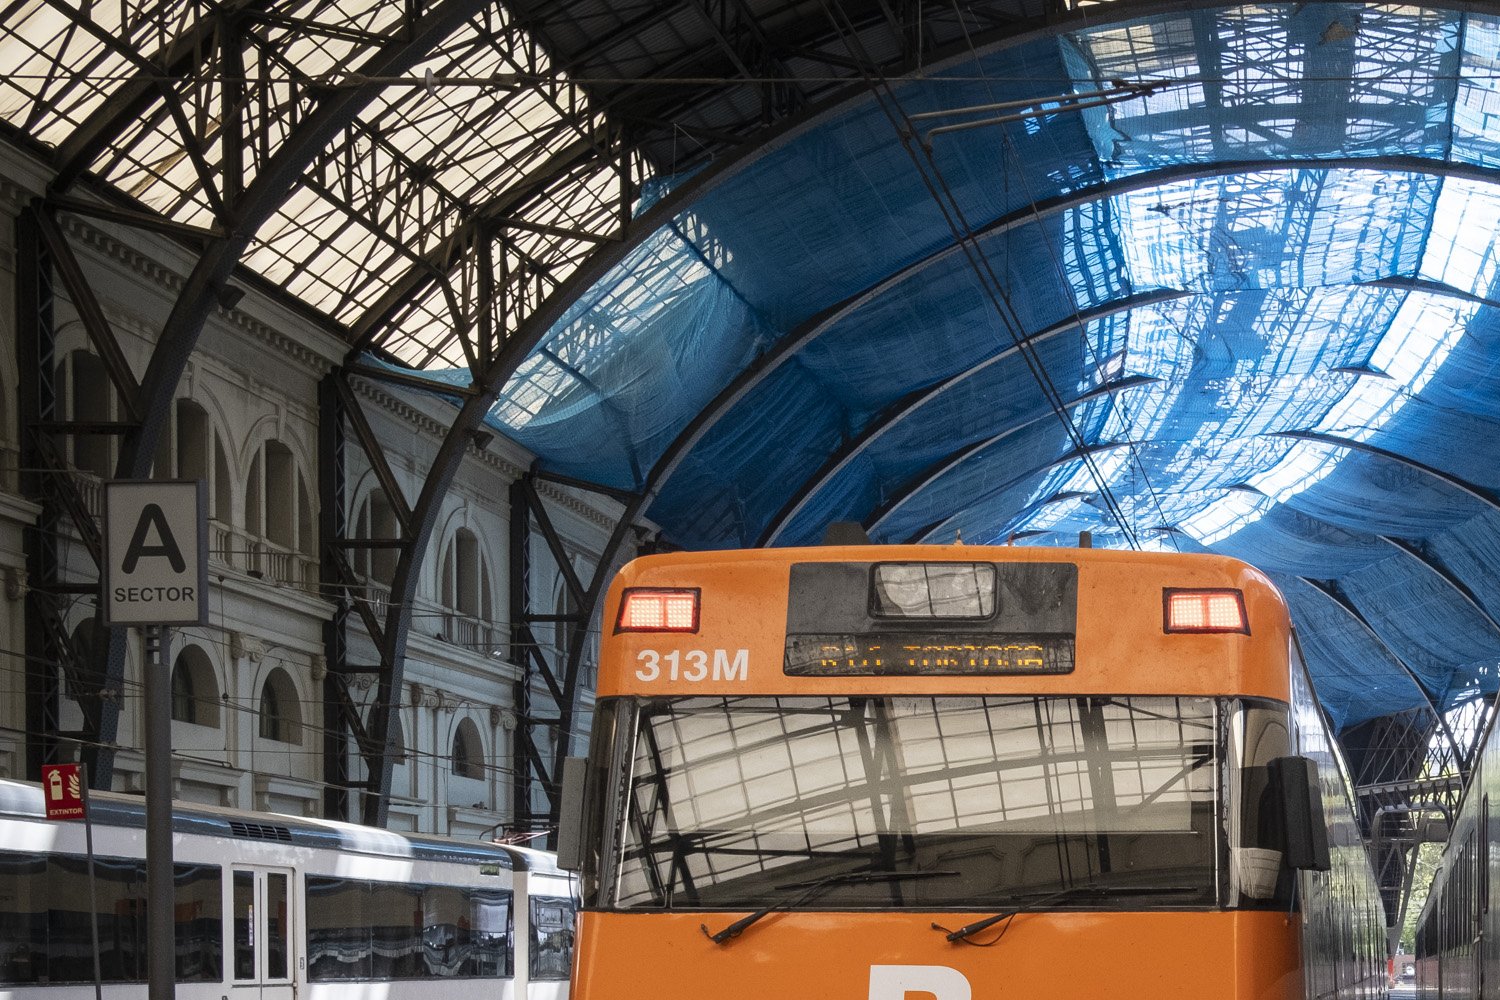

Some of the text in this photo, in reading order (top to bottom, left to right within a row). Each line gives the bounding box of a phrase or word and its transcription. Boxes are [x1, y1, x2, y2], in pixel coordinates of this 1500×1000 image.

[121, 503, 187, 574] A
[115, 586, 194, 603] SECTOR
[635, 648, 749, 682] 313M
[49, 807, 83, 816] EXTINTOR
